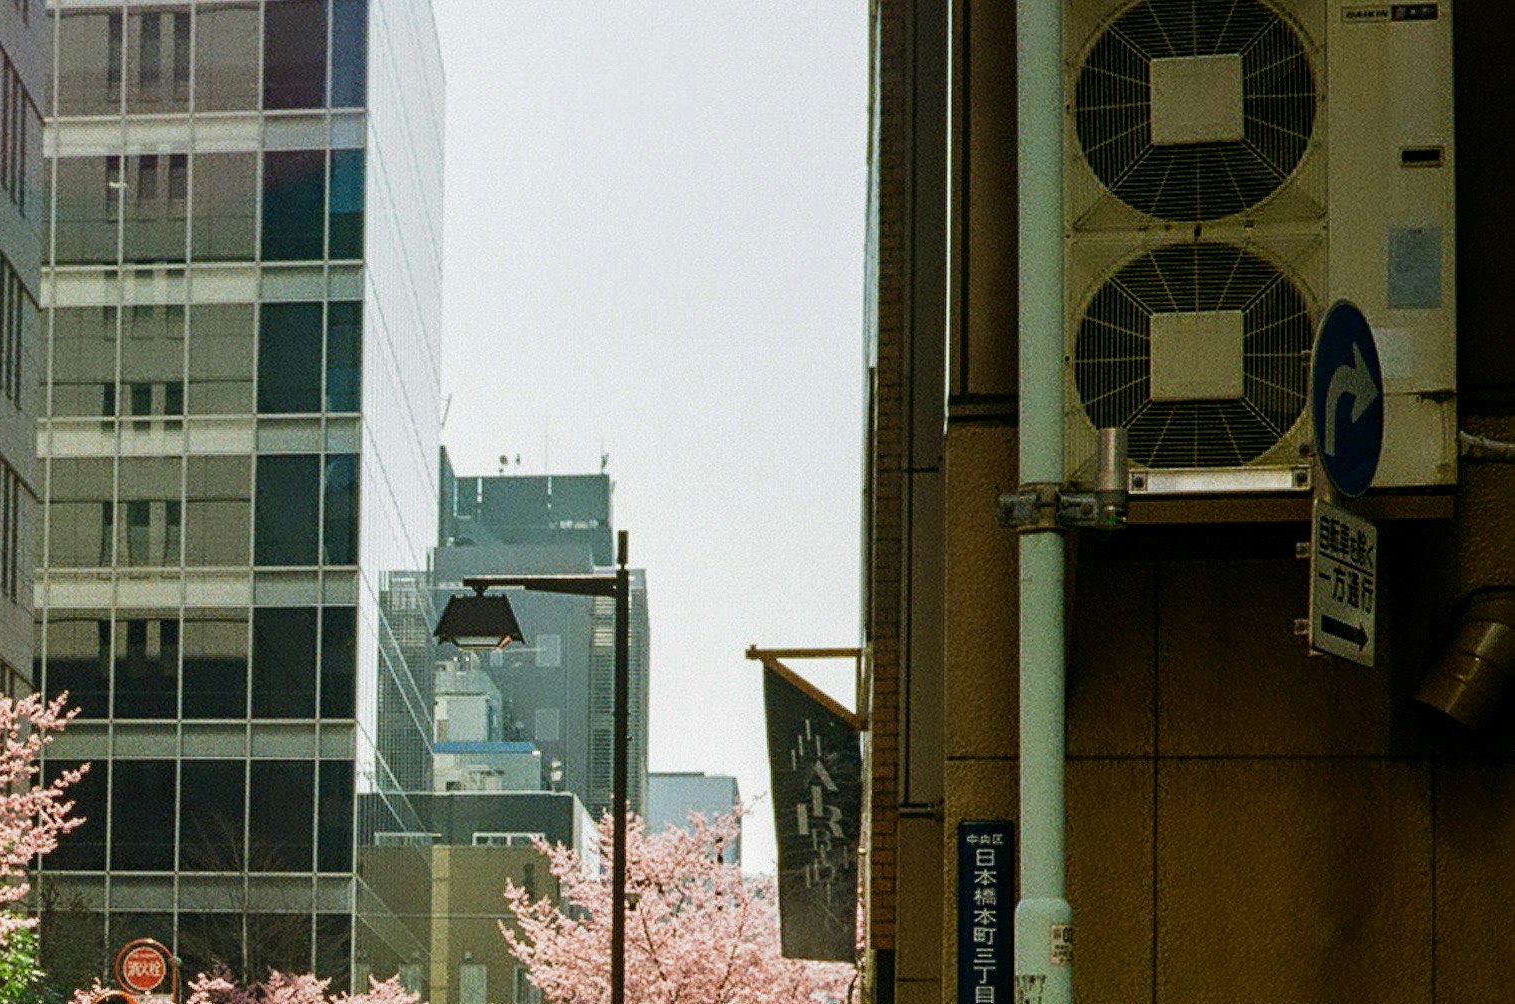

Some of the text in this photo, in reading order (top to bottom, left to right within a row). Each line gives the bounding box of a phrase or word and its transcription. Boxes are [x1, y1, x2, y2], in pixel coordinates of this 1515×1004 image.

[1346, 10, 1388, 18] DAIKIN
[1318, 565, 1374, 614] 一方通行
[966, 834, 1004, 845] 中央区
[128, 961, 161, 976] 消火栓
